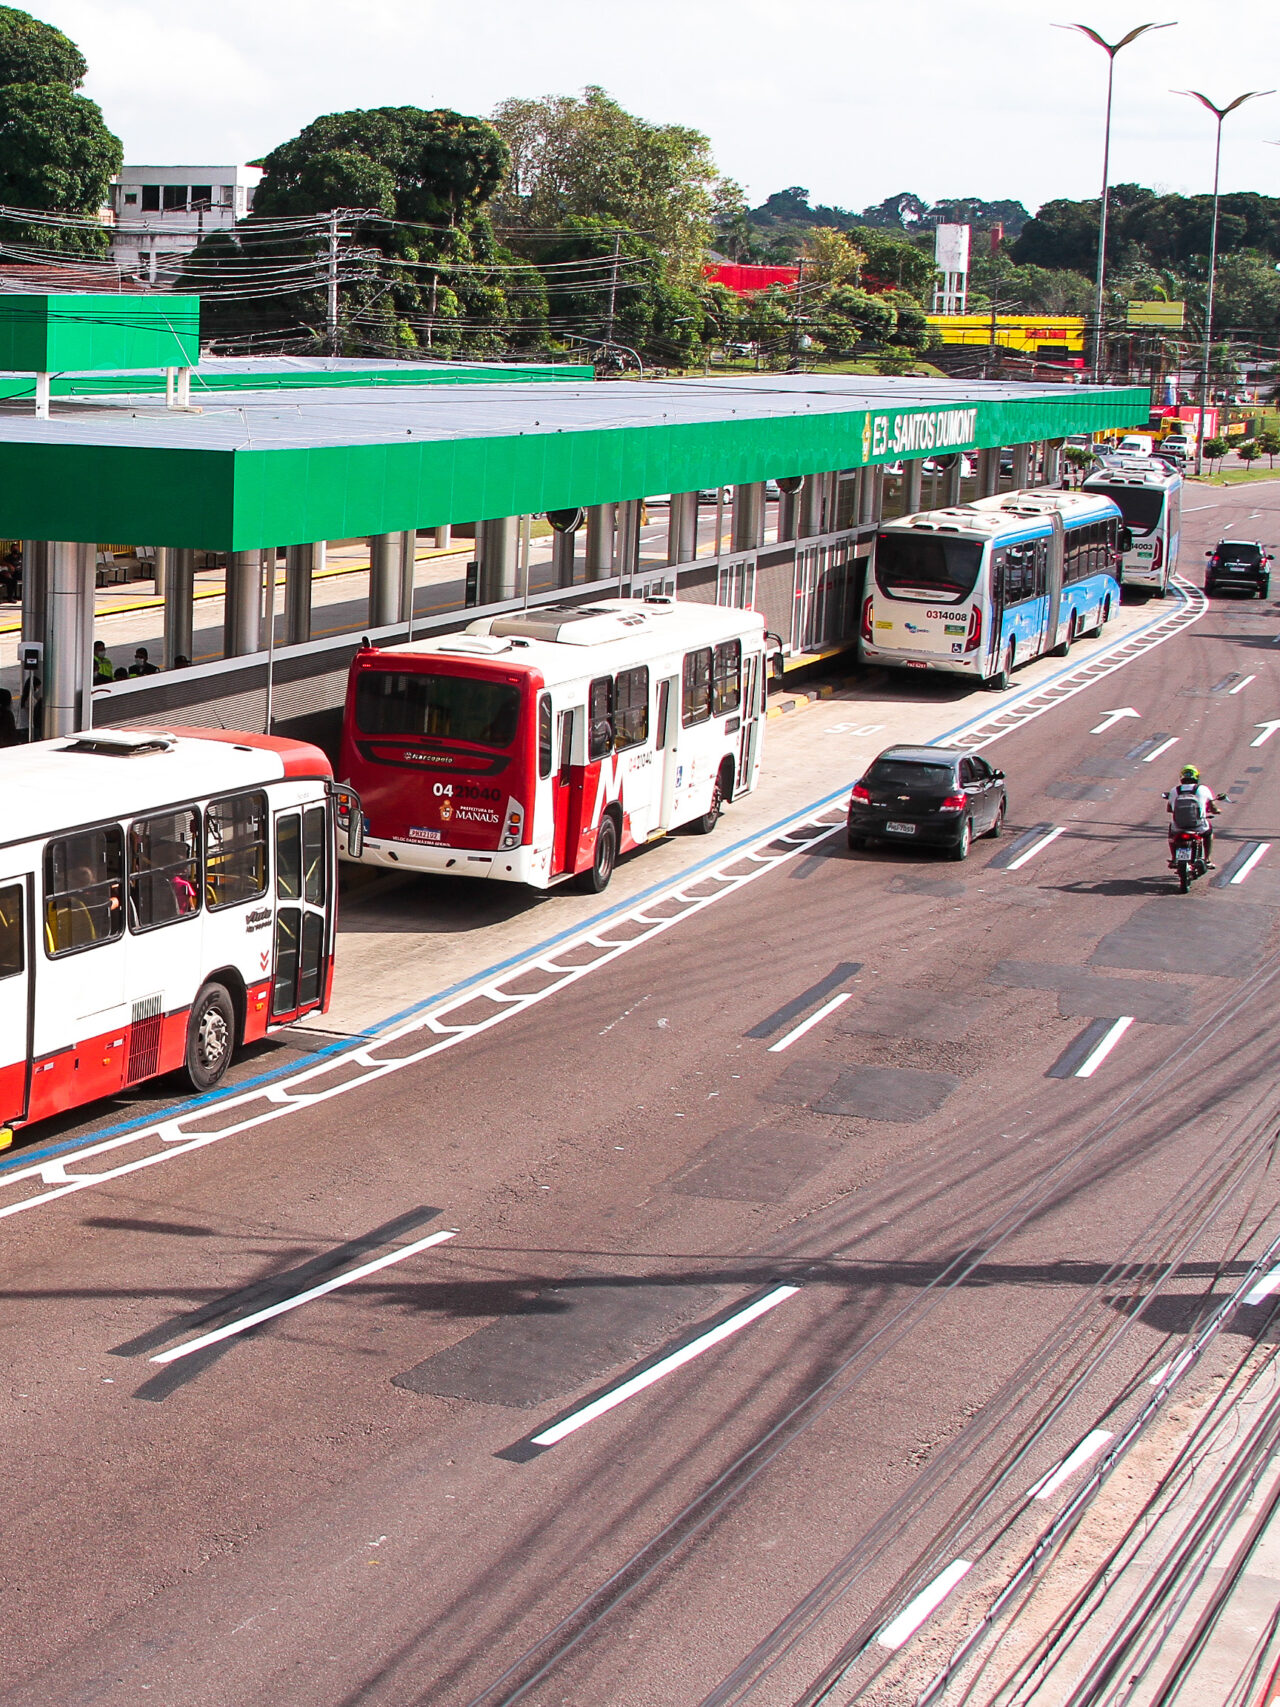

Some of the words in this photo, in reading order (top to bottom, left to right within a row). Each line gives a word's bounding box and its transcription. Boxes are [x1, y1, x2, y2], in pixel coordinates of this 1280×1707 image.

[935, 408, 978, 448] DUMONT
[926, 610, 967, 622] 0314008
[455, 809, 500, 824] MANAUS
